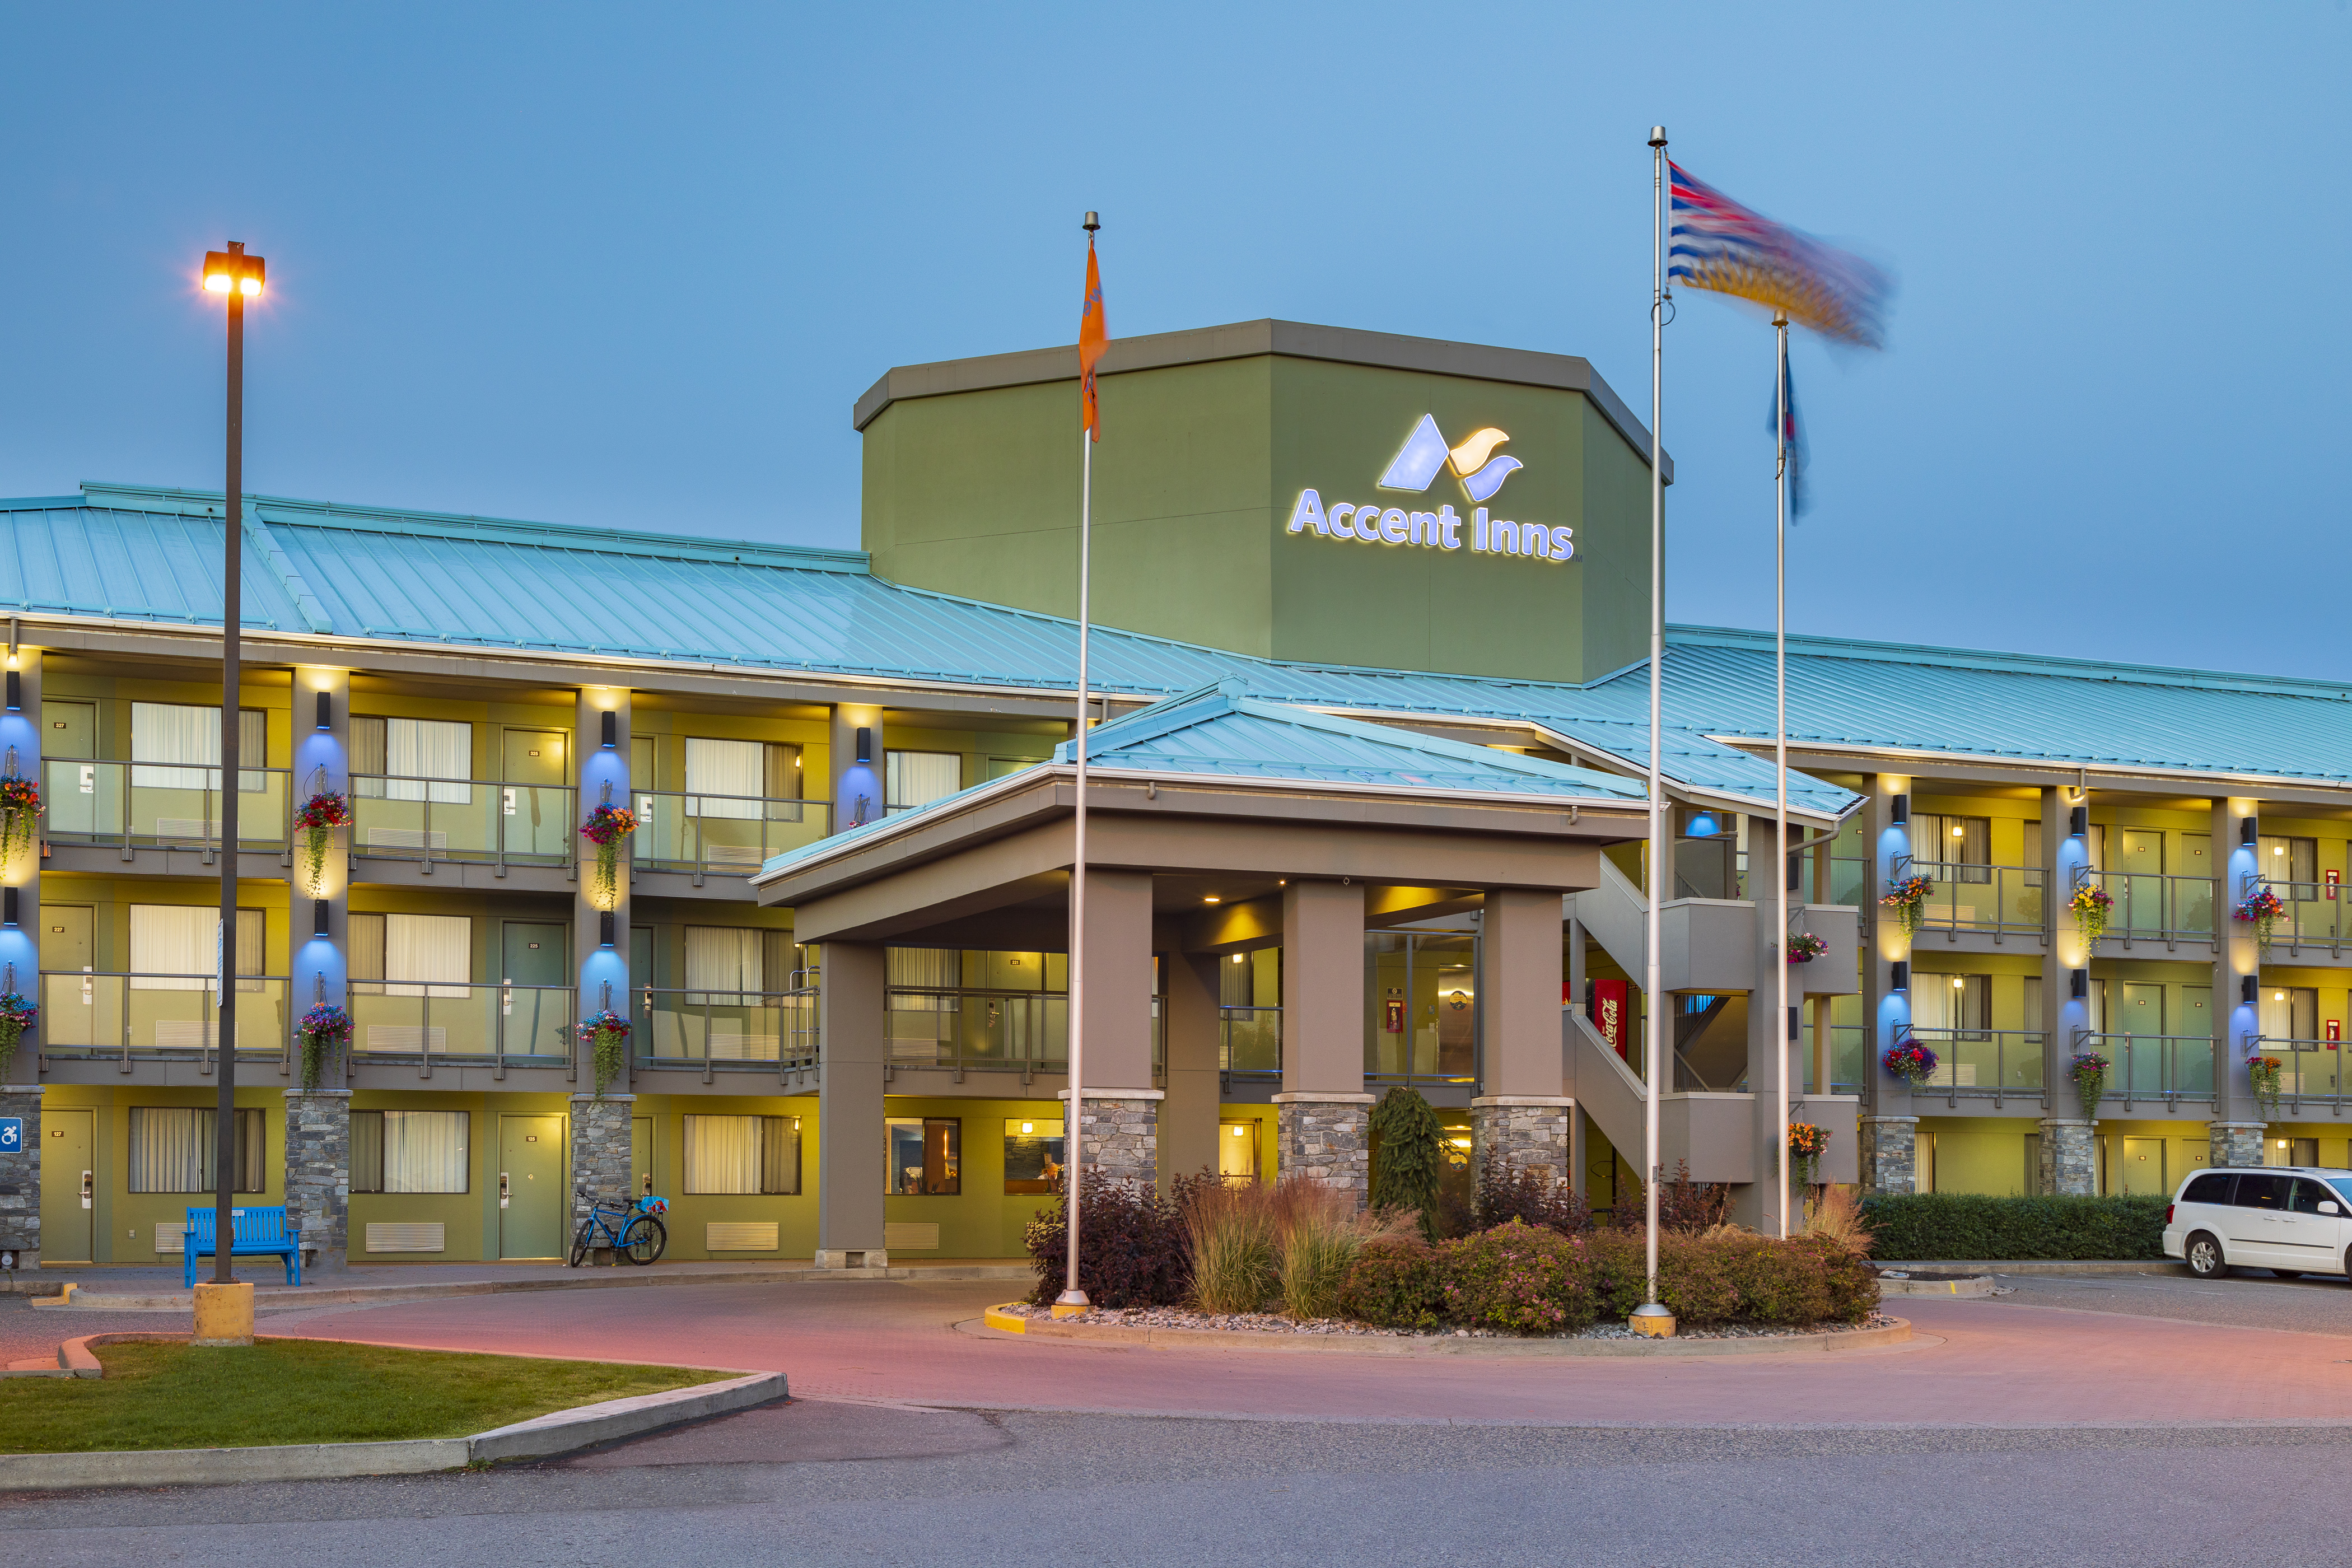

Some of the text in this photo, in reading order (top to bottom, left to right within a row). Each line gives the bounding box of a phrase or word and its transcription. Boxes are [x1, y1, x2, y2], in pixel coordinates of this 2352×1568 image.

[1289, 488, 1461, 549] Accent
[1473, 507, 1574, 560] Inns
[1602, 997, 1617, 1048] oca-Cola
